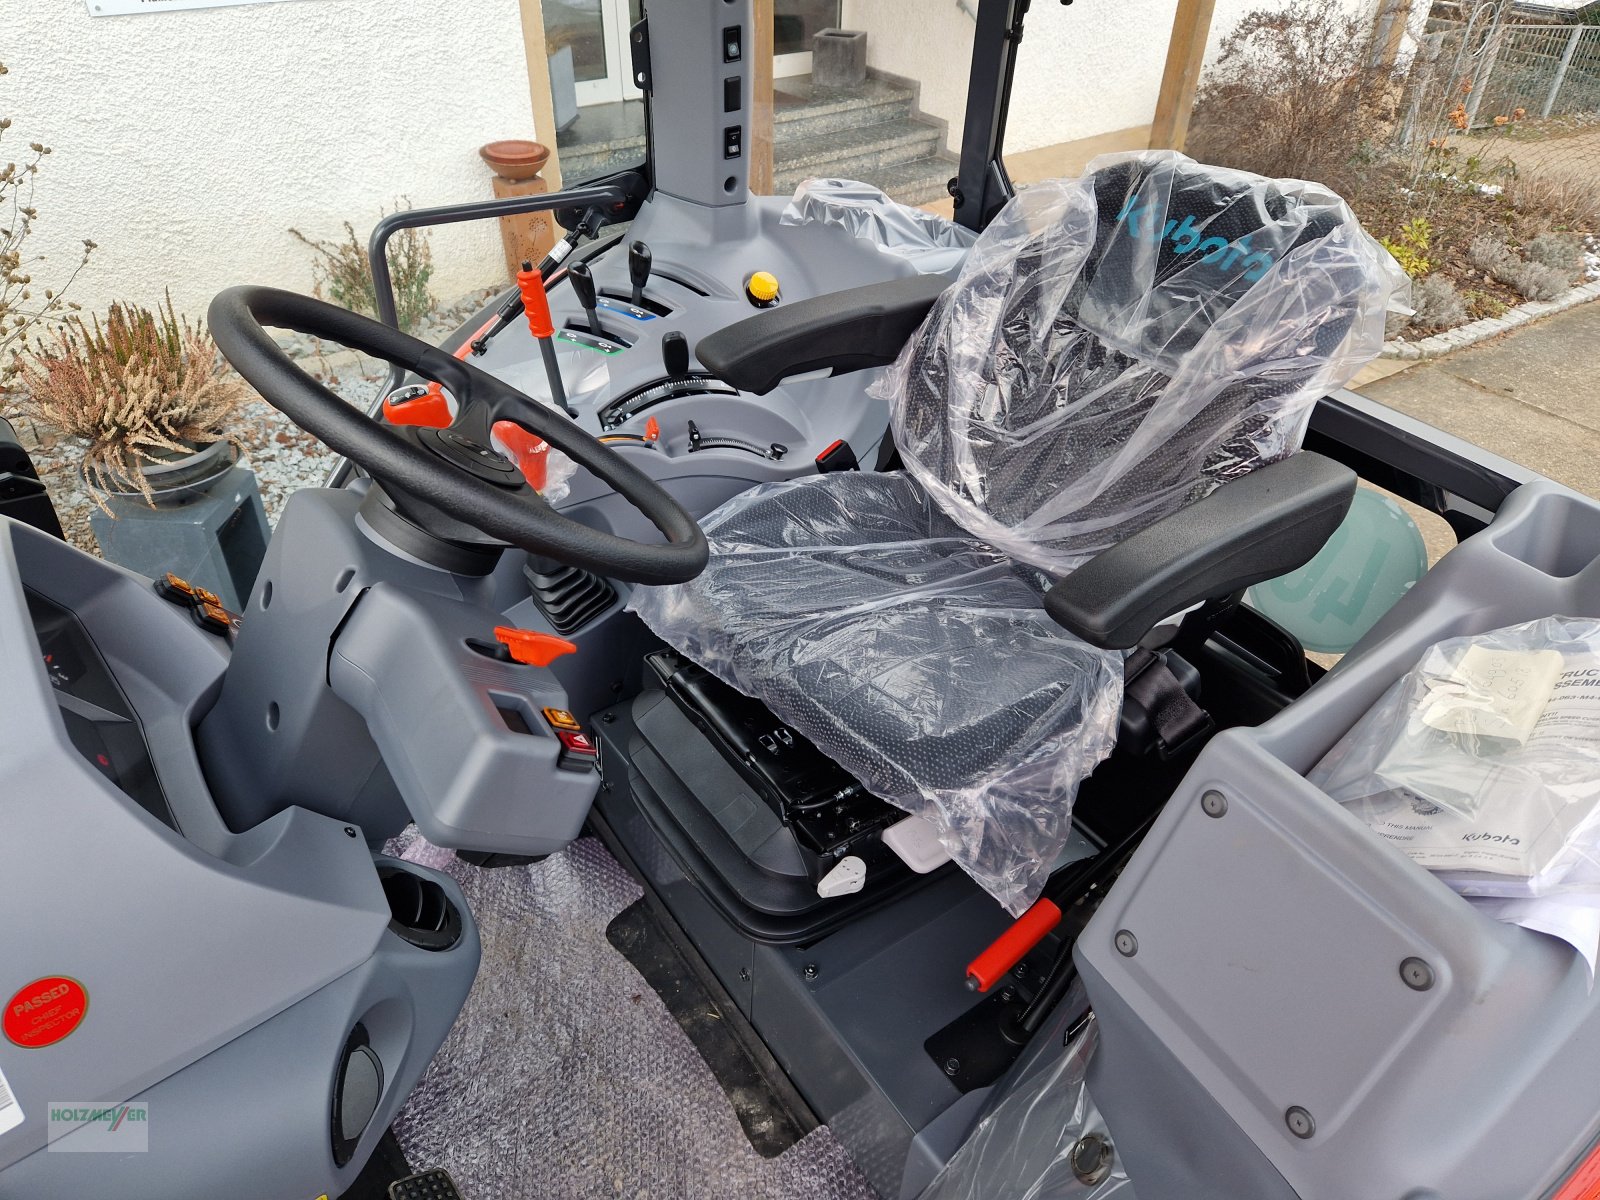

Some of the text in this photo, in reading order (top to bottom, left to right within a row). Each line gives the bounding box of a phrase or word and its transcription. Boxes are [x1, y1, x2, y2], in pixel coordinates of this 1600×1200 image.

[1116, 194, 1274, 284] Kubota
[1461, 831, 1521, 846] Kubota
[13, 983, 70, 1017] PASSED
[31, 1004, 64, 1026] CHIEF
[20, 1006, 81, 1042] INSPECTOR
